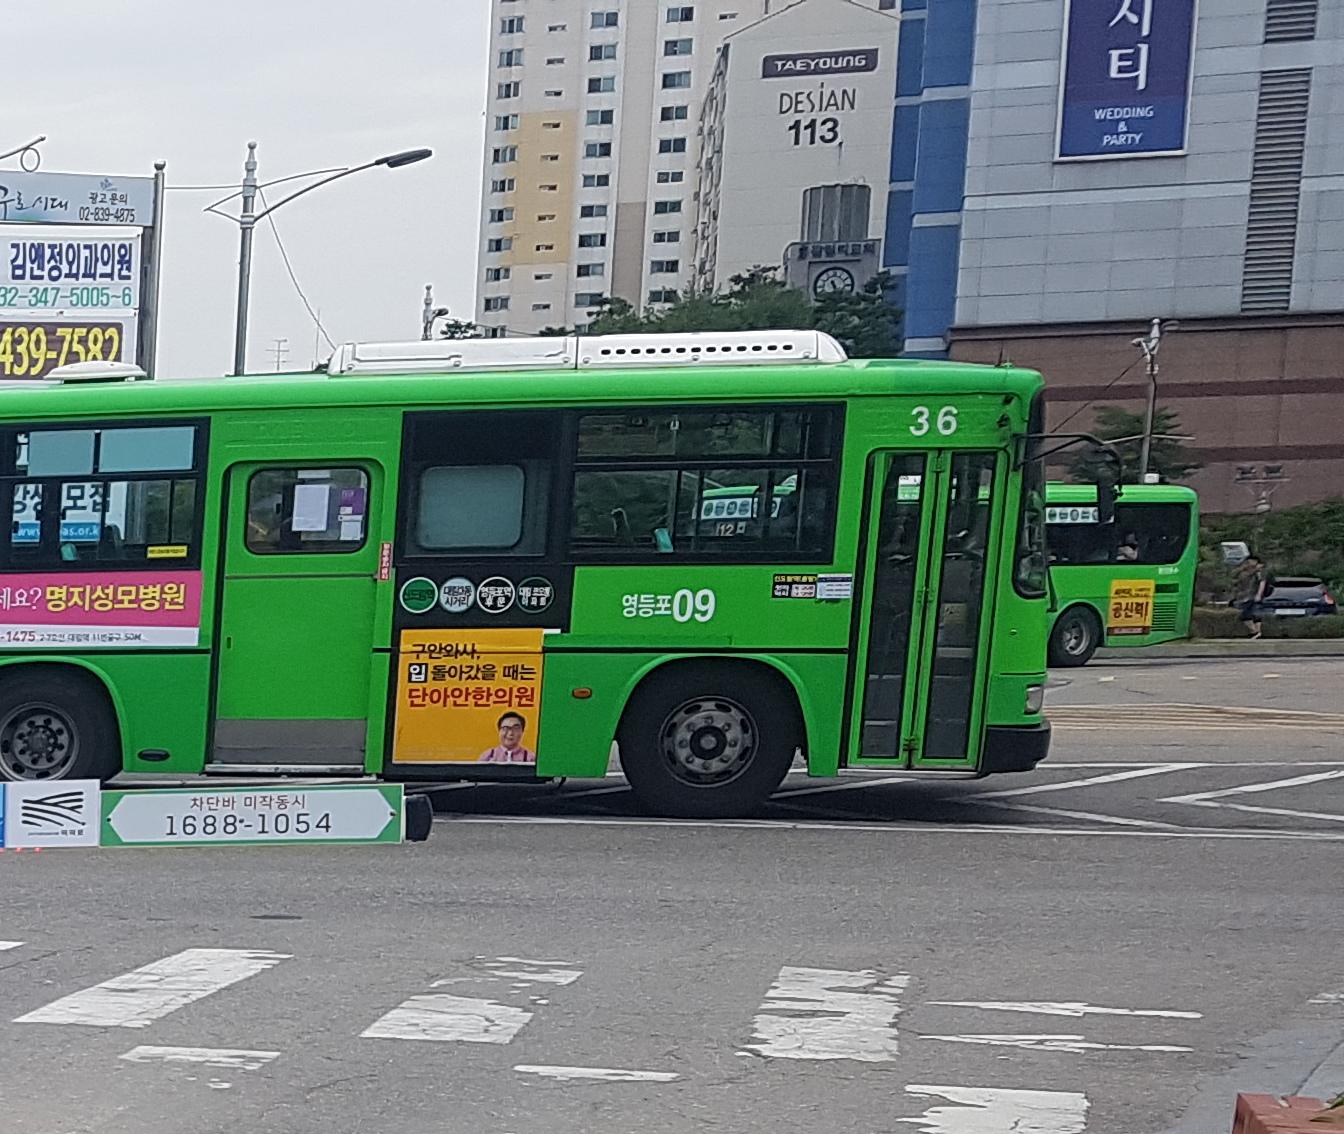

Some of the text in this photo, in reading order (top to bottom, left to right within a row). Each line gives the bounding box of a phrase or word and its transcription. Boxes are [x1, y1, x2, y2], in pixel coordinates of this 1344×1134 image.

[1094, 105, 1155, 120] WEDDING
[787, 117, 840, 146] 113
[1118, 121, 1128, 132] &
[1102, 133, 1143, 146] PARTY
[89, 192, 128, 206] 광고 문의
[909, 405, 959, 437] 36
[45, 583, 186, 612] 명지성모병원
[412, 643, 481, 660] 구안와사,
[409, 664, 537, 682] 입 돌아갔을 때는
[408, 686, 535, 708] 단아안한의원
[190, 793, 307, 811] 차단바 미작동시
[165, 813, 333, 837] 1688-1054
